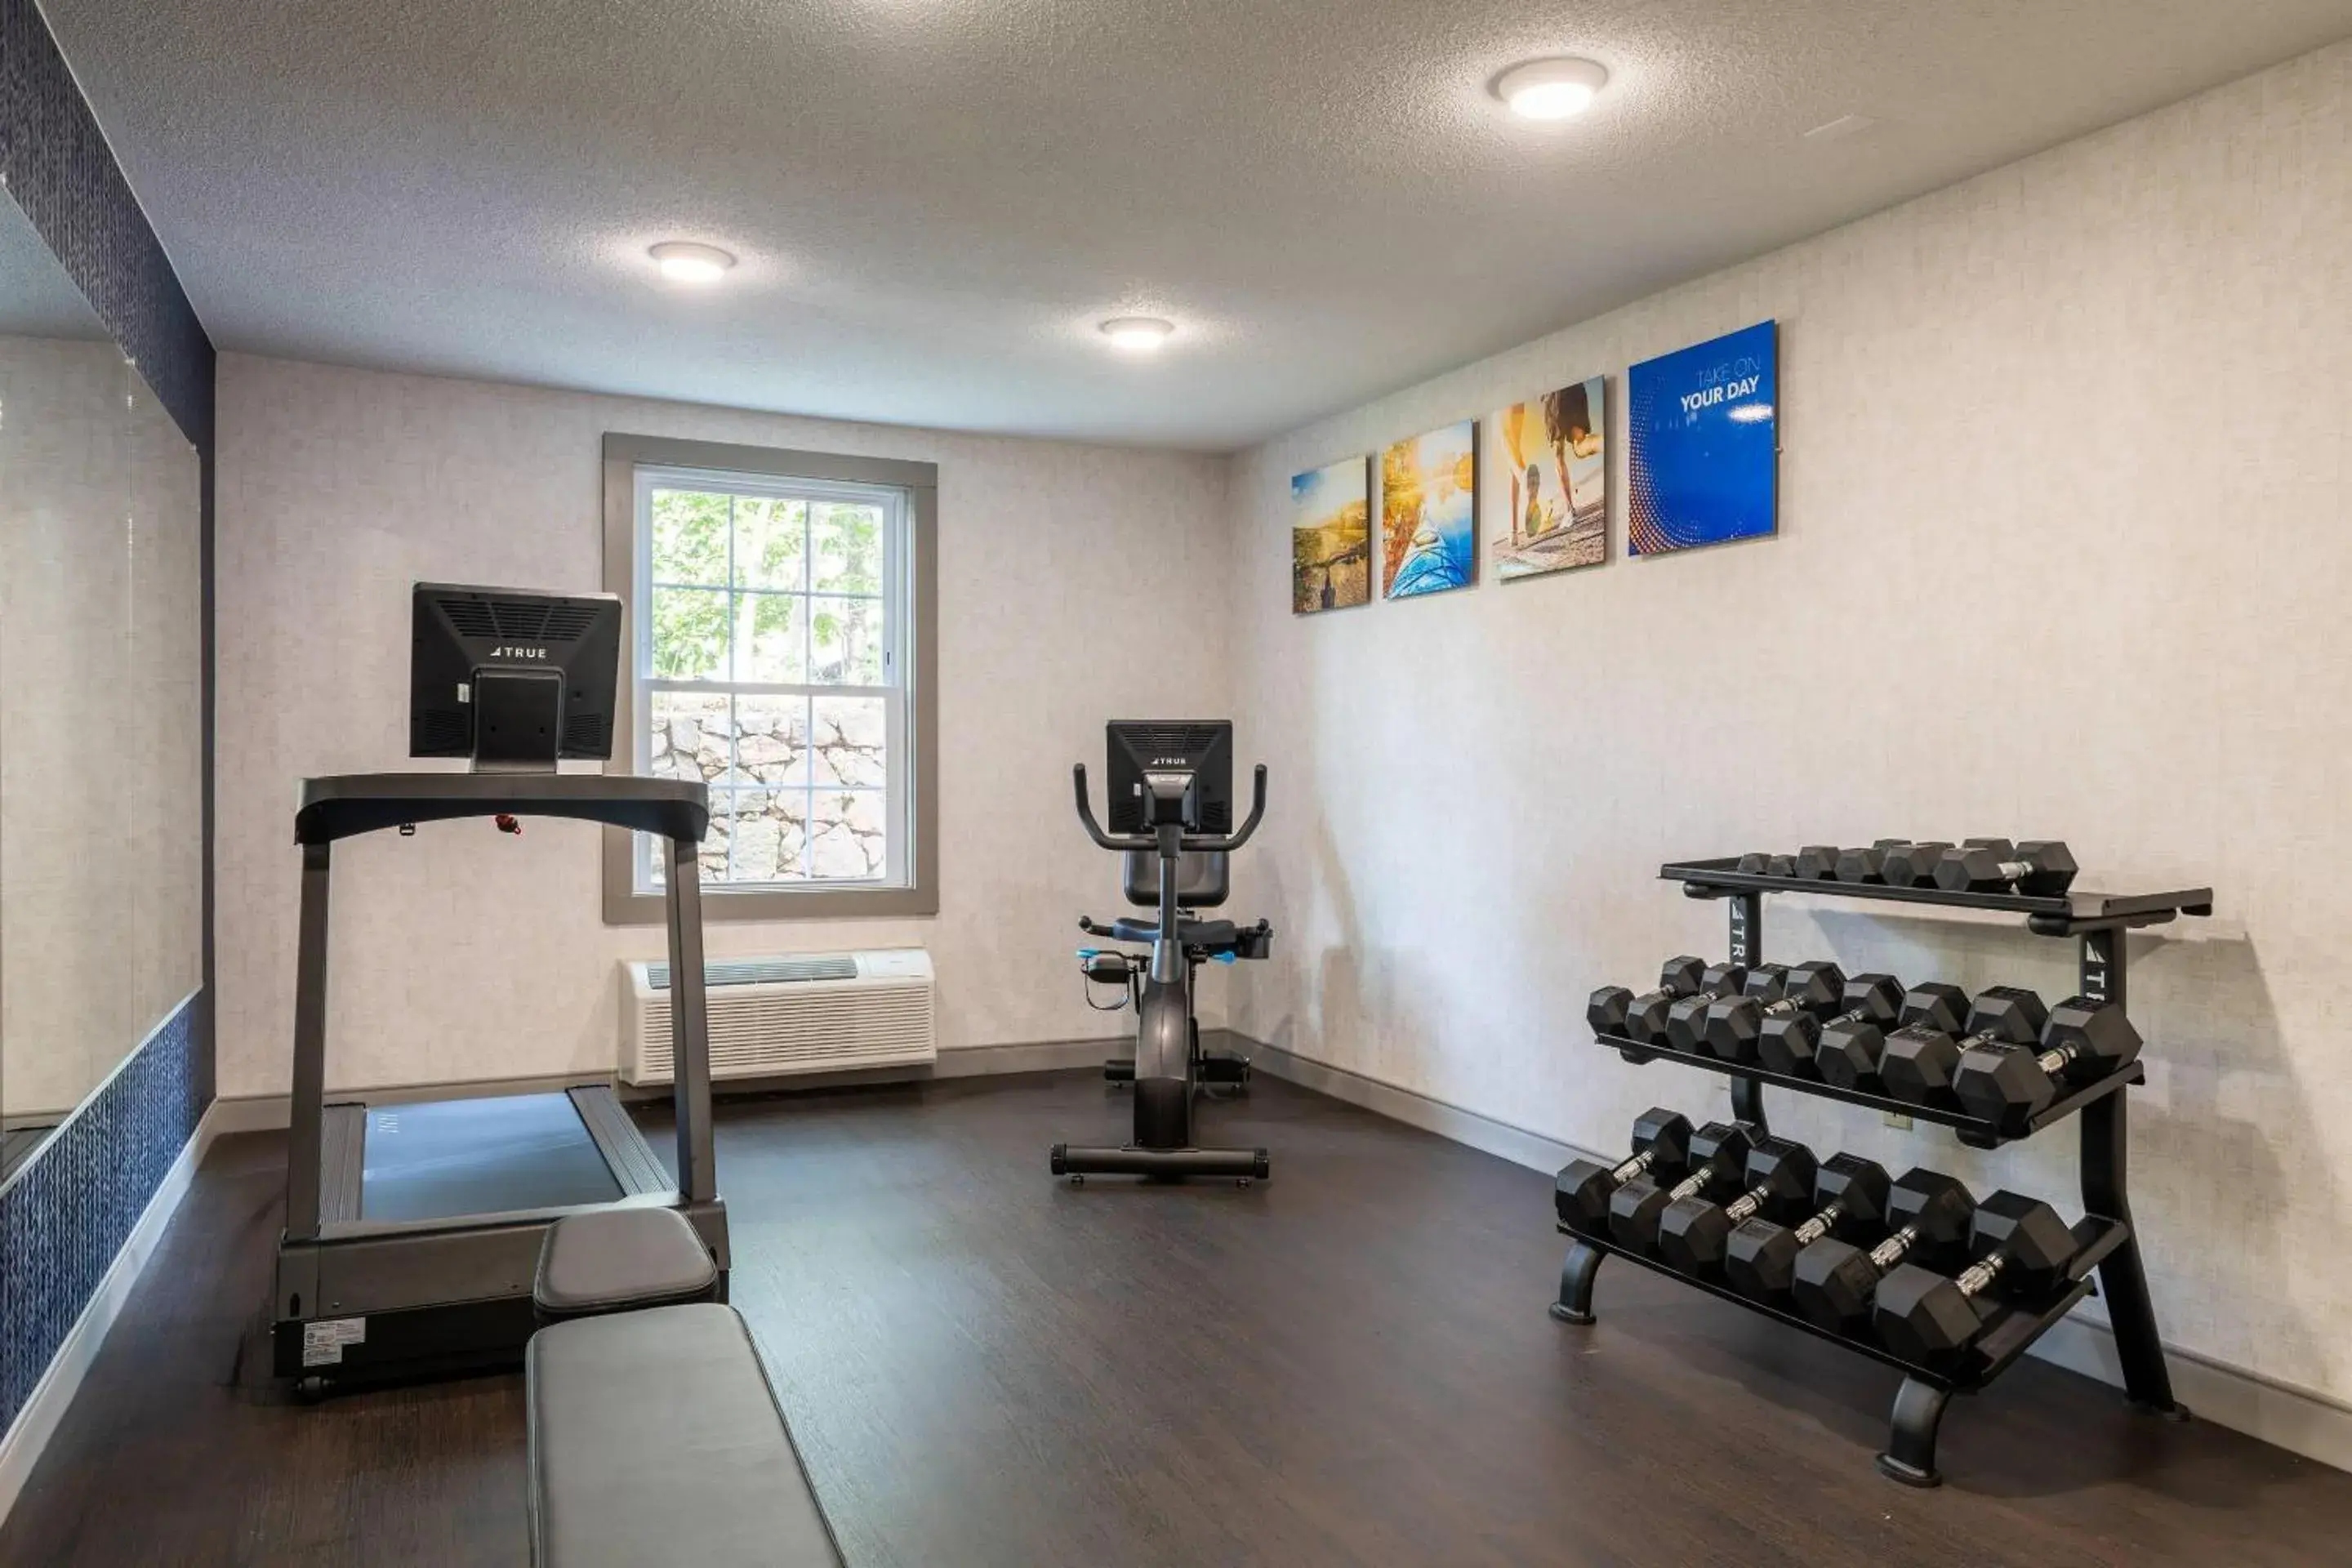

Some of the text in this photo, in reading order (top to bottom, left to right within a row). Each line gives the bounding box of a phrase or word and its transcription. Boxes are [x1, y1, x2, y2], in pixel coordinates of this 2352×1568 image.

[1696, 354, 1761, 388] TAKE ON
[1680, 374, 1760, 412] YOUR DAY
[504, 647, 546, 658] TRUE
